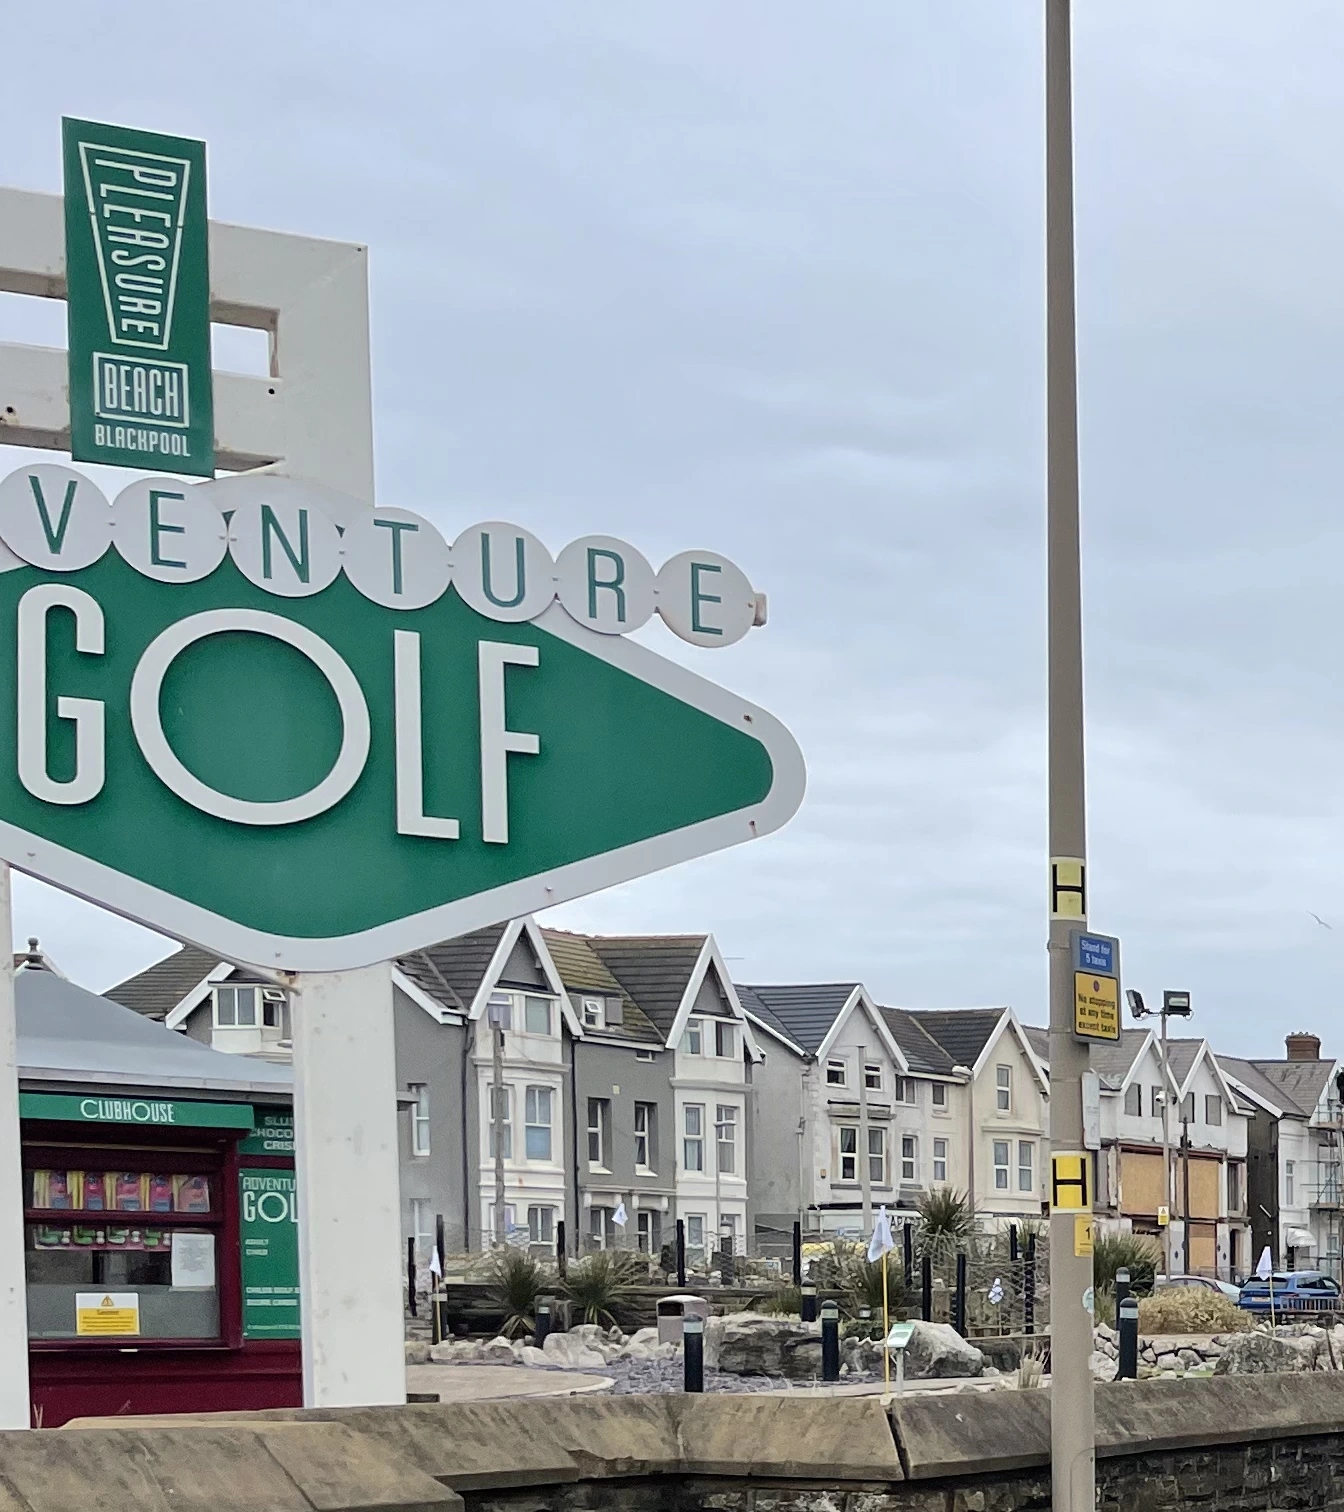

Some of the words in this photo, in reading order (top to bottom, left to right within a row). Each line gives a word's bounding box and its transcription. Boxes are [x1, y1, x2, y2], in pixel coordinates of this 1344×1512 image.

[95, 158, 177, 337] PLEASURE
[104, 363, 179, 418] BEACH
[95, 424, 191, 457] BLACKPOOL
[27, 475, 724, 636] VENTURE
[16, 583, 540, 845] GOLF
[1052, 864, 1086, 914] H
[1081, 940, 1100, 953] Stand
[1101, 944, 1110, 955] for
[1086, 953, 1091, 964] 5
[1091, 954, 1106, 966] taxis
[80, 1099, 175, 1123] CLUBHOUSE
[1052, 1158, 1087, 1207] H
